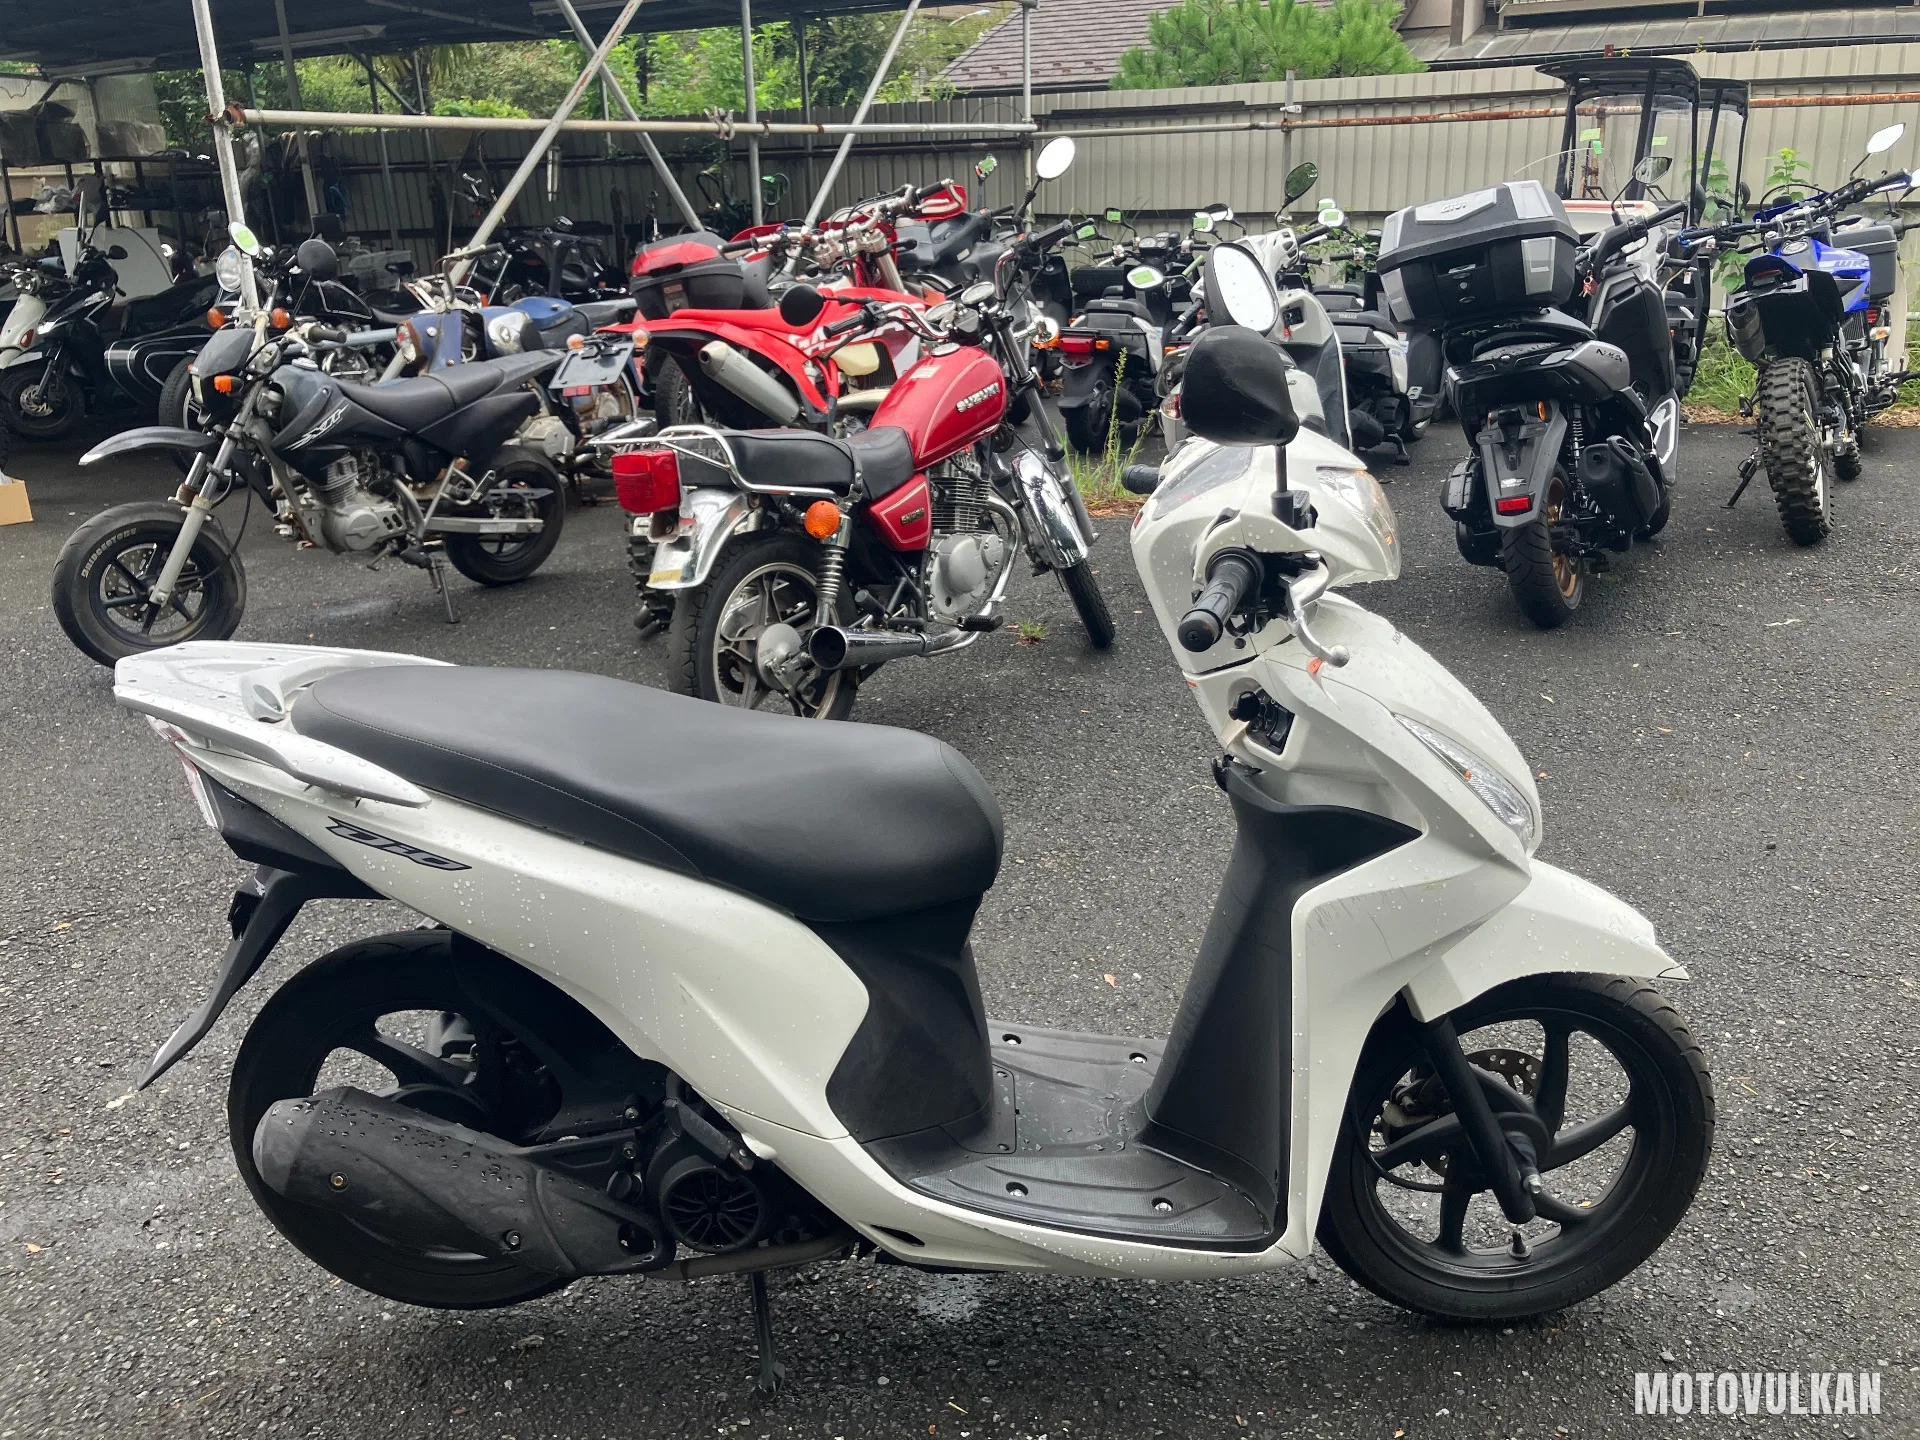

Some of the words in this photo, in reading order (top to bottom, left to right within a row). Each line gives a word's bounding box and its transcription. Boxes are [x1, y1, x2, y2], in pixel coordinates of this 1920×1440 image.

[1440, 200, 1466, 213] GIVI
[956, 381, 1000, 413] SUZUKI
[81, 527, 137, 579] BRIDGESTONE
